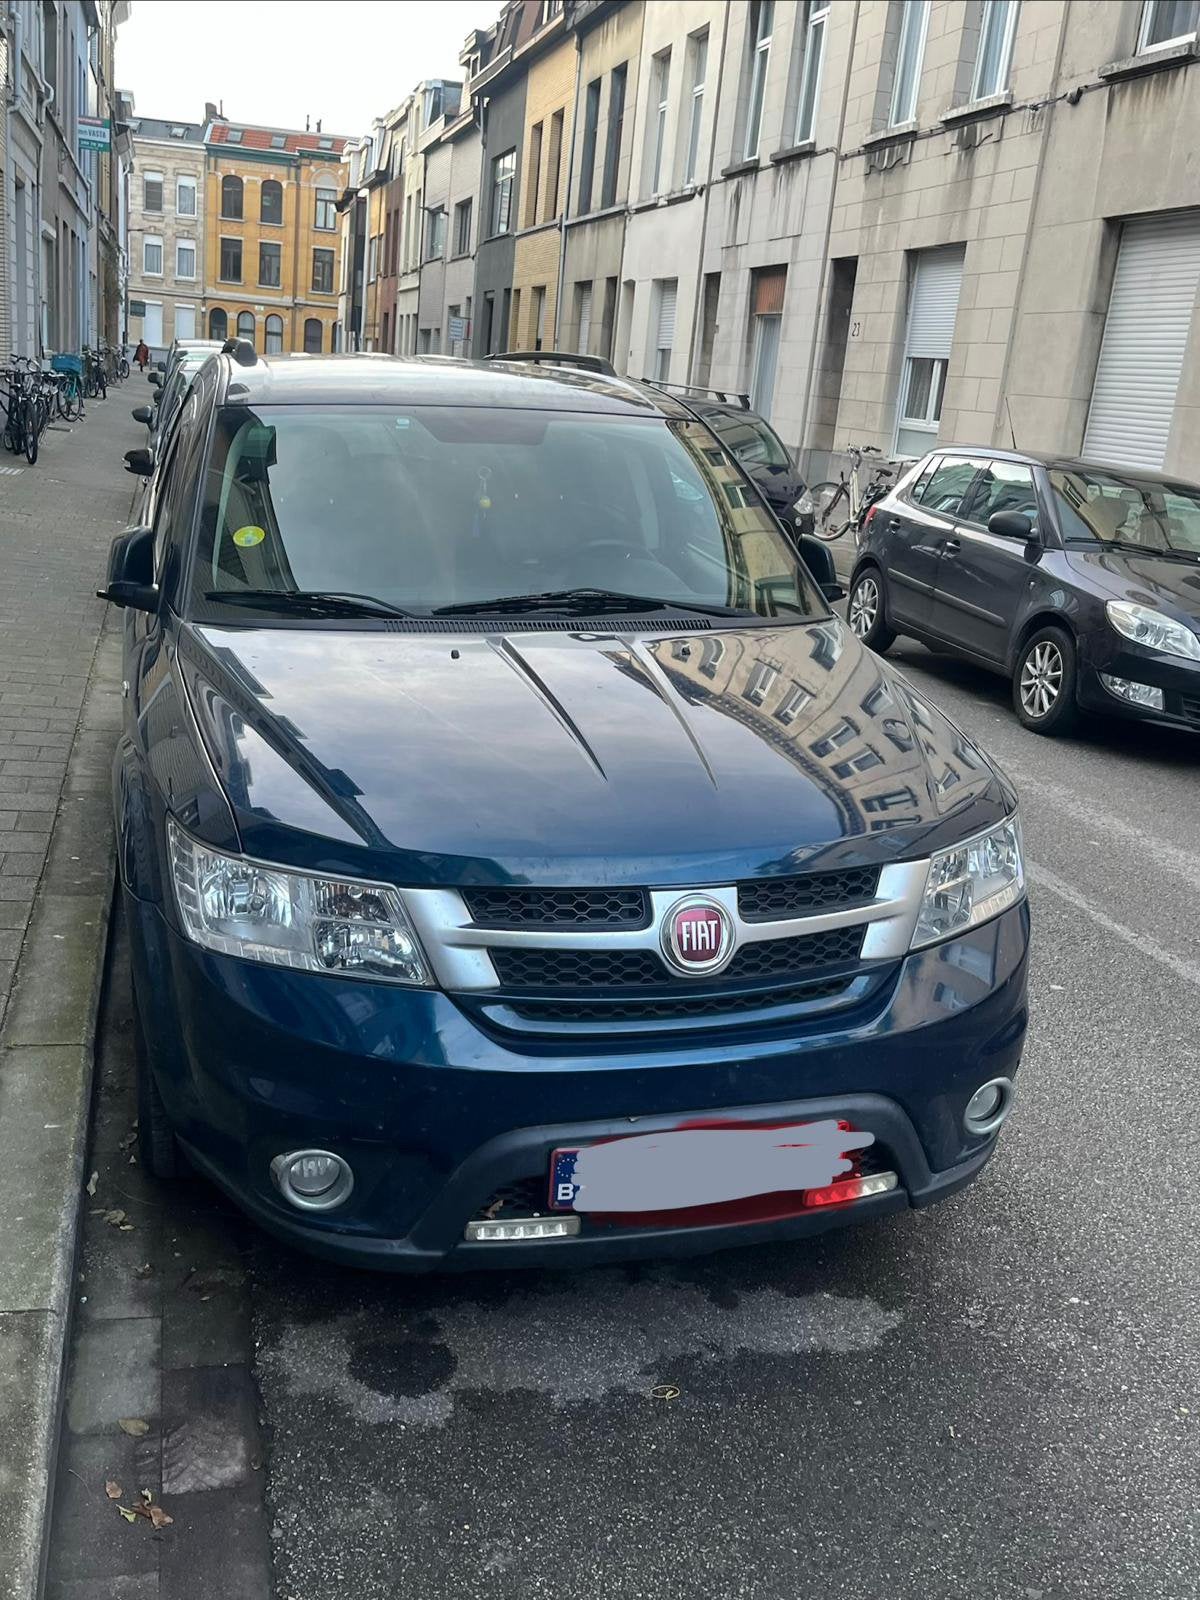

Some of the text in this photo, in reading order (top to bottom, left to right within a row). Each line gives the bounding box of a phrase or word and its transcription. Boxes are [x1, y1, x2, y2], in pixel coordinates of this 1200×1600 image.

[852, 322, 860, 337] 23
[681, 920, 718, 951] FIAT
[557, 1183, 574, 1200] B
